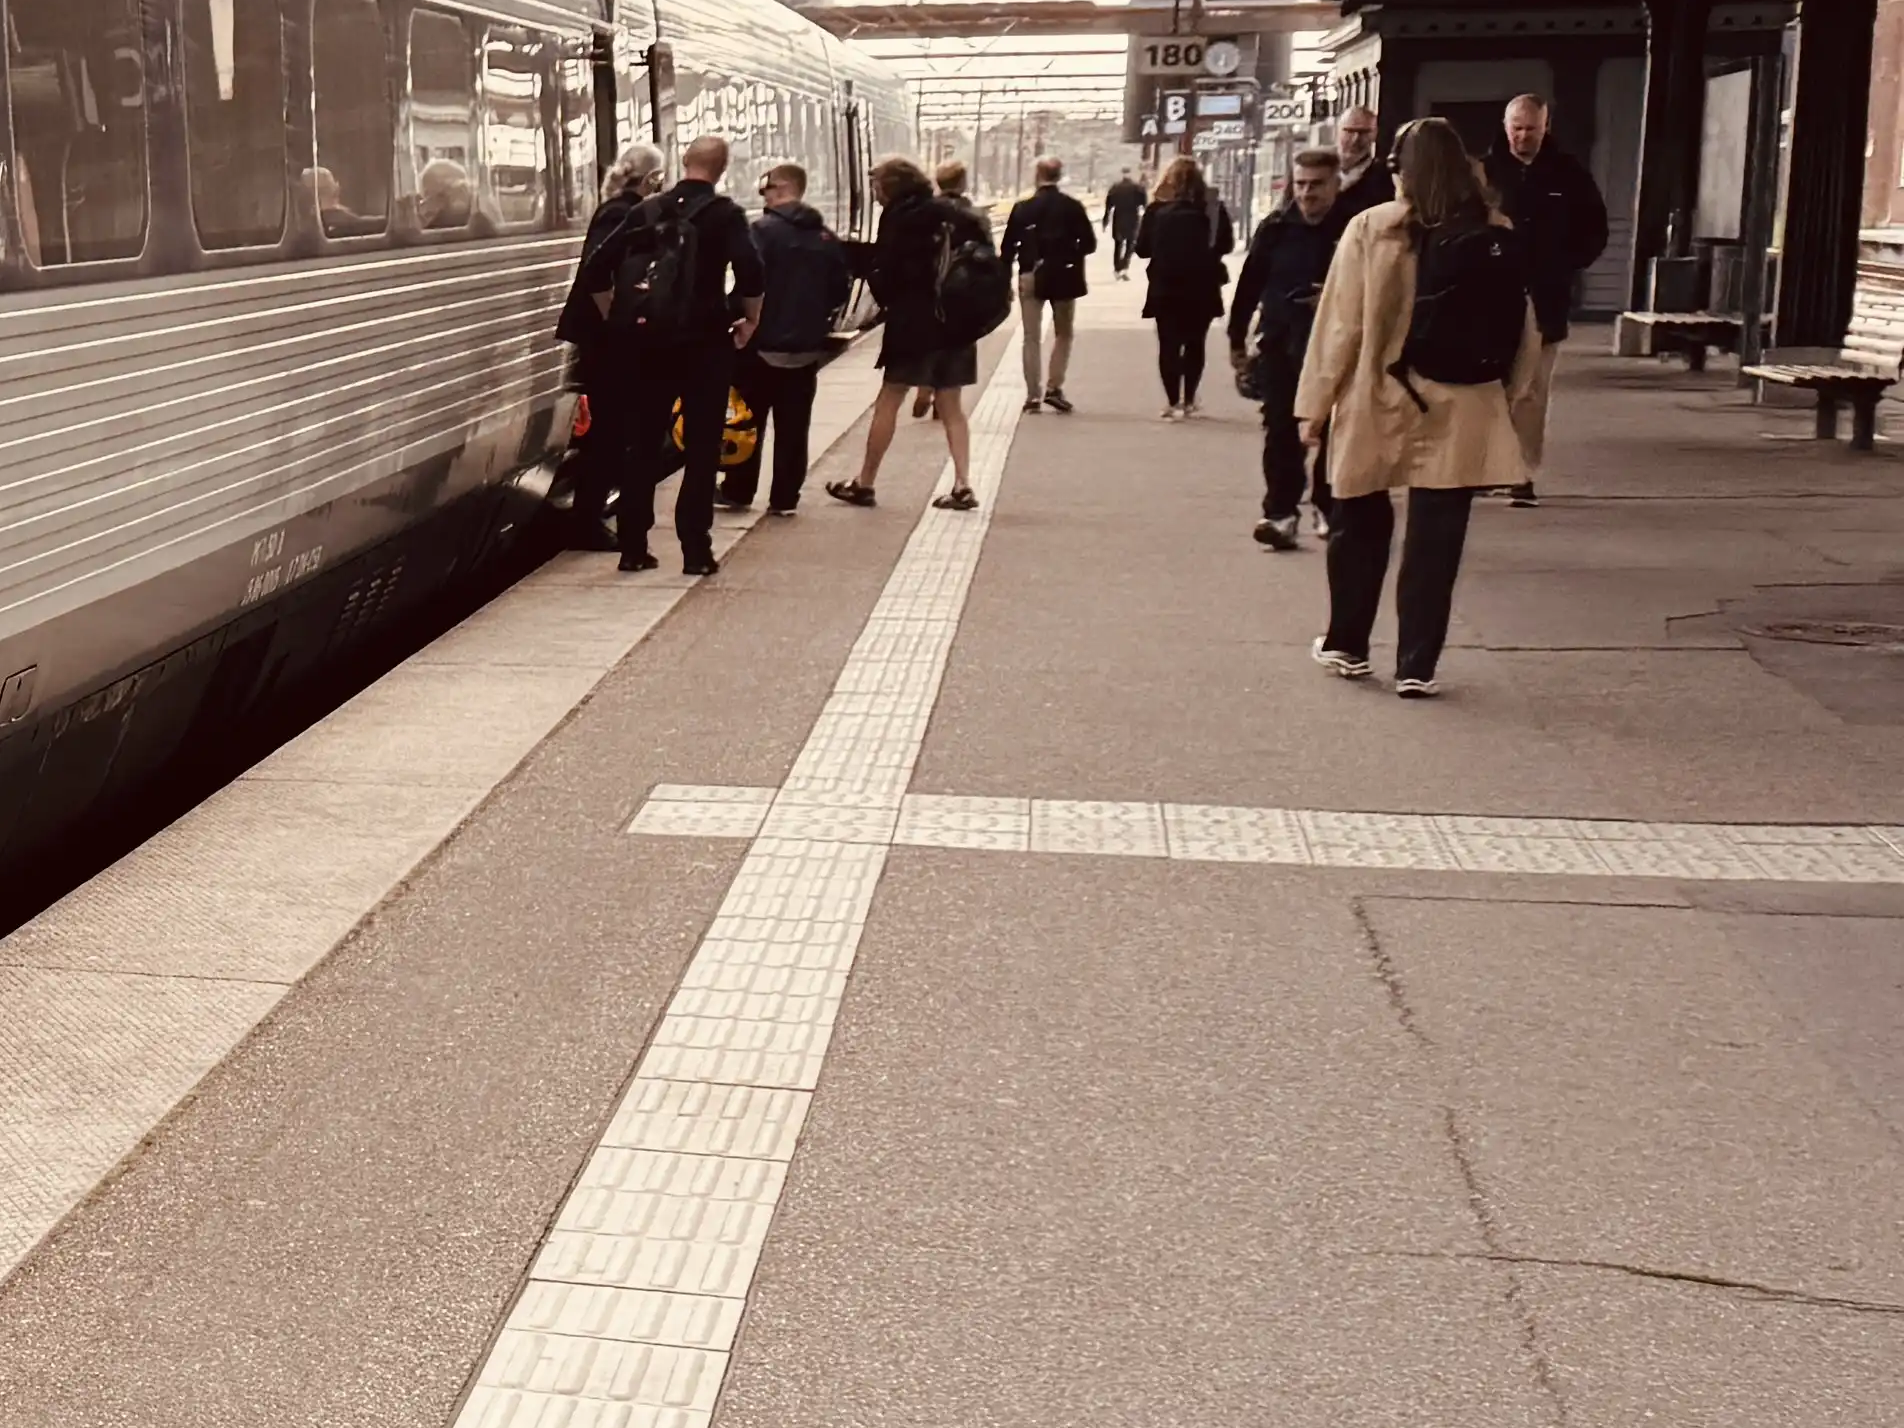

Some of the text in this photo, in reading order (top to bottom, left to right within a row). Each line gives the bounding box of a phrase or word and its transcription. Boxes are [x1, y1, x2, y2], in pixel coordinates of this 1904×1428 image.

[1145, 44, 1203, 68] 180
[1165, 95, 1187, 121] B
[1266, 103, 1305, 120] 200
[1141, 119, 1159, 137] A
